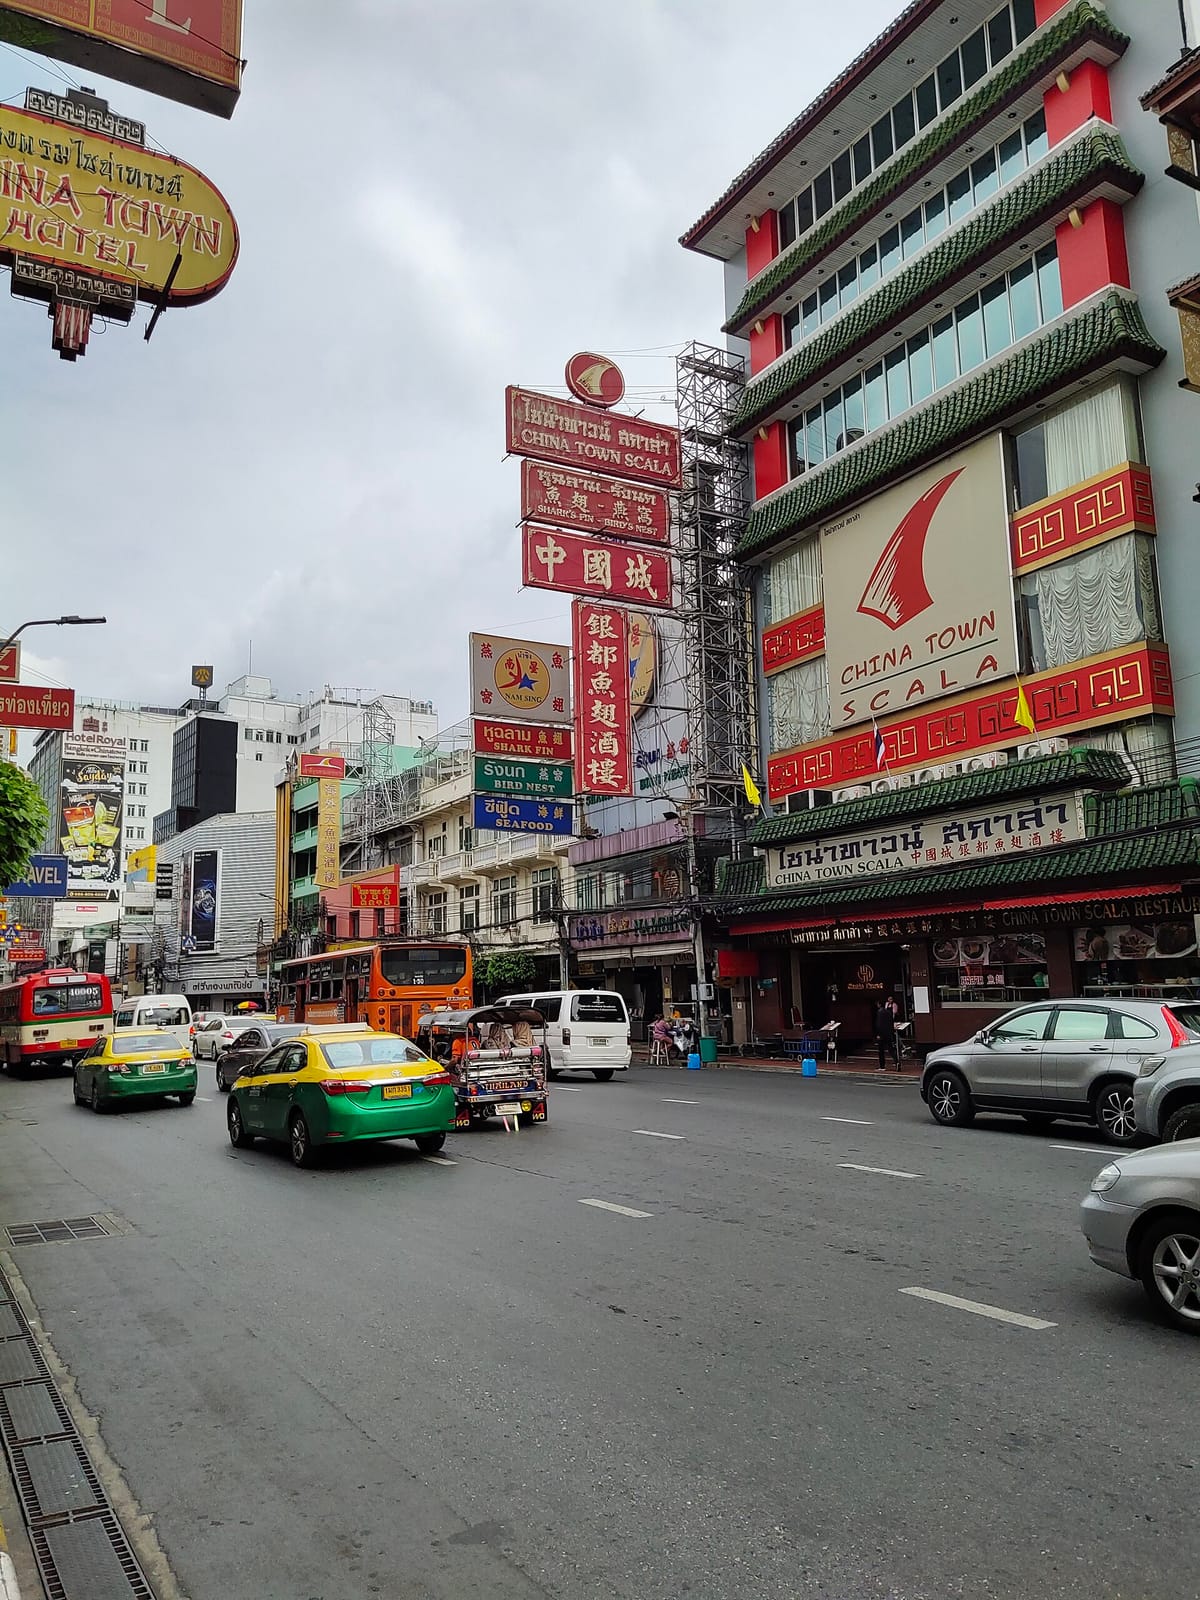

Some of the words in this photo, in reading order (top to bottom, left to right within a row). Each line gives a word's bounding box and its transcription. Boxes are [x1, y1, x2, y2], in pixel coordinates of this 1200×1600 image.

[96, 186, 224, 258] TOWN
[6, 208, 149, 273] HOTEL
[521, 428, 571, 453] CHINA
[574, 441, 621, 465] TOWN
[624, 453, 673, 477] SCALA
[537, 504, 577, 520] SHARK'S
[580, 513, 595, 524] FIN
[604, 518, 634, 531] BIRD'S
[635, 525, 658, 536] NEST
[535, 535, 659, 600] 中國城
[840, 643, 913, 686] CHINA
[924, 610, 996, 654] TOWN
[504, 692, 523, 701] NAM
[524, 695, 543, 703] SING
[583, 612, 624, 789] 銀都魚翅酒樓
[842, 654, 998, 722] SCALA
[66, 733, 95, 743] Hotel
[96, 735, 126, 748] Royal
[483, 725, 532, 743] หูฉลาม
[537, 729, 564, 746] 魚翅
[493, 741, 533, 754] SHARK
[535, 745, 554, 756] FIN
[484, 760, 526, 778] รังนก
[494, 779, 524, 790] BIRD
[526, 782, 556, 793] NEST
[495, 818, 554, 831] SEAFOOD
[538, 804, 565, 821] 海鮮
[771, 822, 925, 870] ไชน่าทาวน์
[942, 798, 1071, 845] สกาล่า
[910, 828, 1067, 864] 中國城銀都魚翅酒樓
[15, 866, 63, 885] AVEL
[774, 870, 811, 885] CHINA
[815, 864, 854, 880] TOWN
[857, 856, 905, 873] SCALA
[1002, 911, 1039, 927] CHINA
[1043, 906, 1081, 924] TOWN
[1084, 902, 1130, 921] SCALA
[484, 1080, 529, 1090] THAILAND
